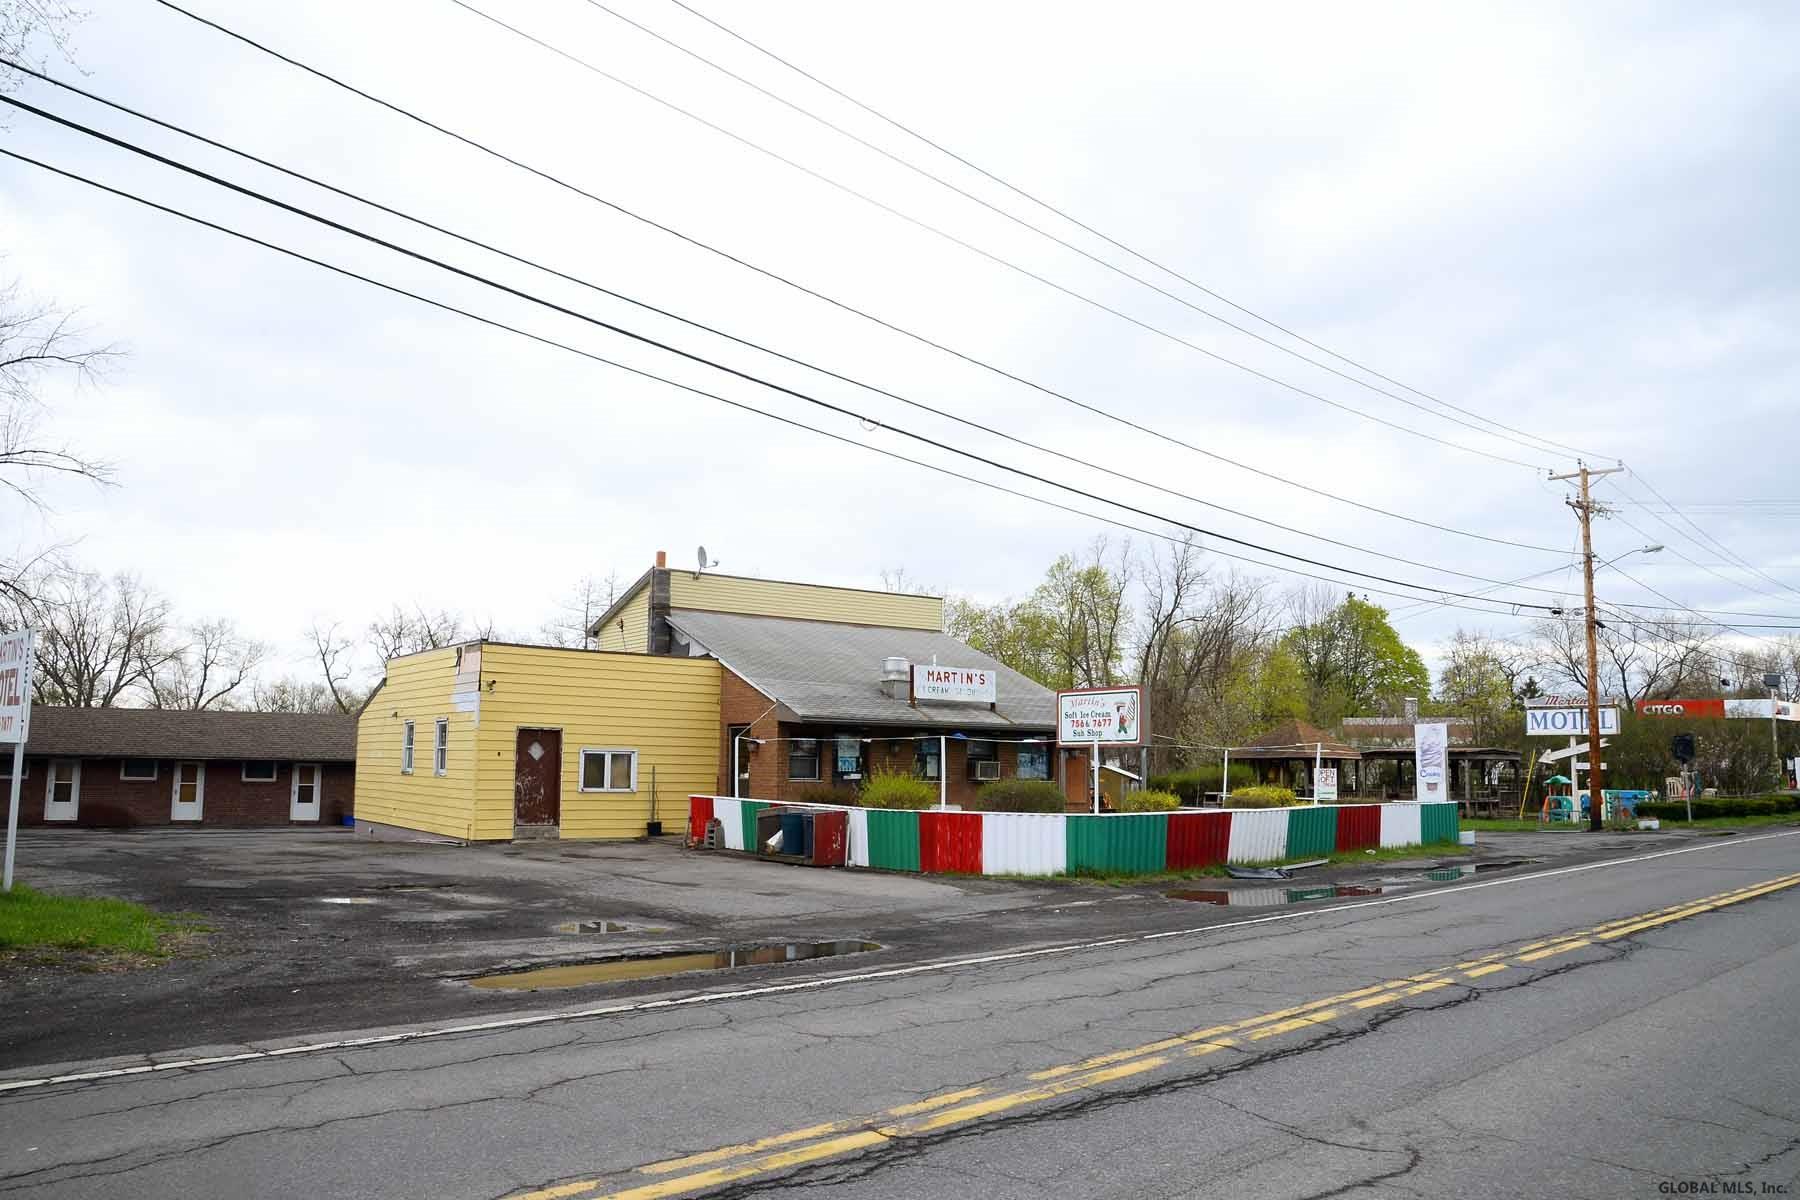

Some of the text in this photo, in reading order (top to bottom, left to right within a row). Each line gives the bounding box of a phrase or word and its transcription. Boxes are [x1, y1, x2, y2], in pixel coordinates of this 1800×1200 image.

[927, 670, 985, 685] MARTIN'S
[1643, 704, 1684, 715] CITGO
[1092, 719, 1112, 727] 7677
[1530, 711, 1613, 730] MOTL
[1072, 729, 1103, 738] Sub Shop
